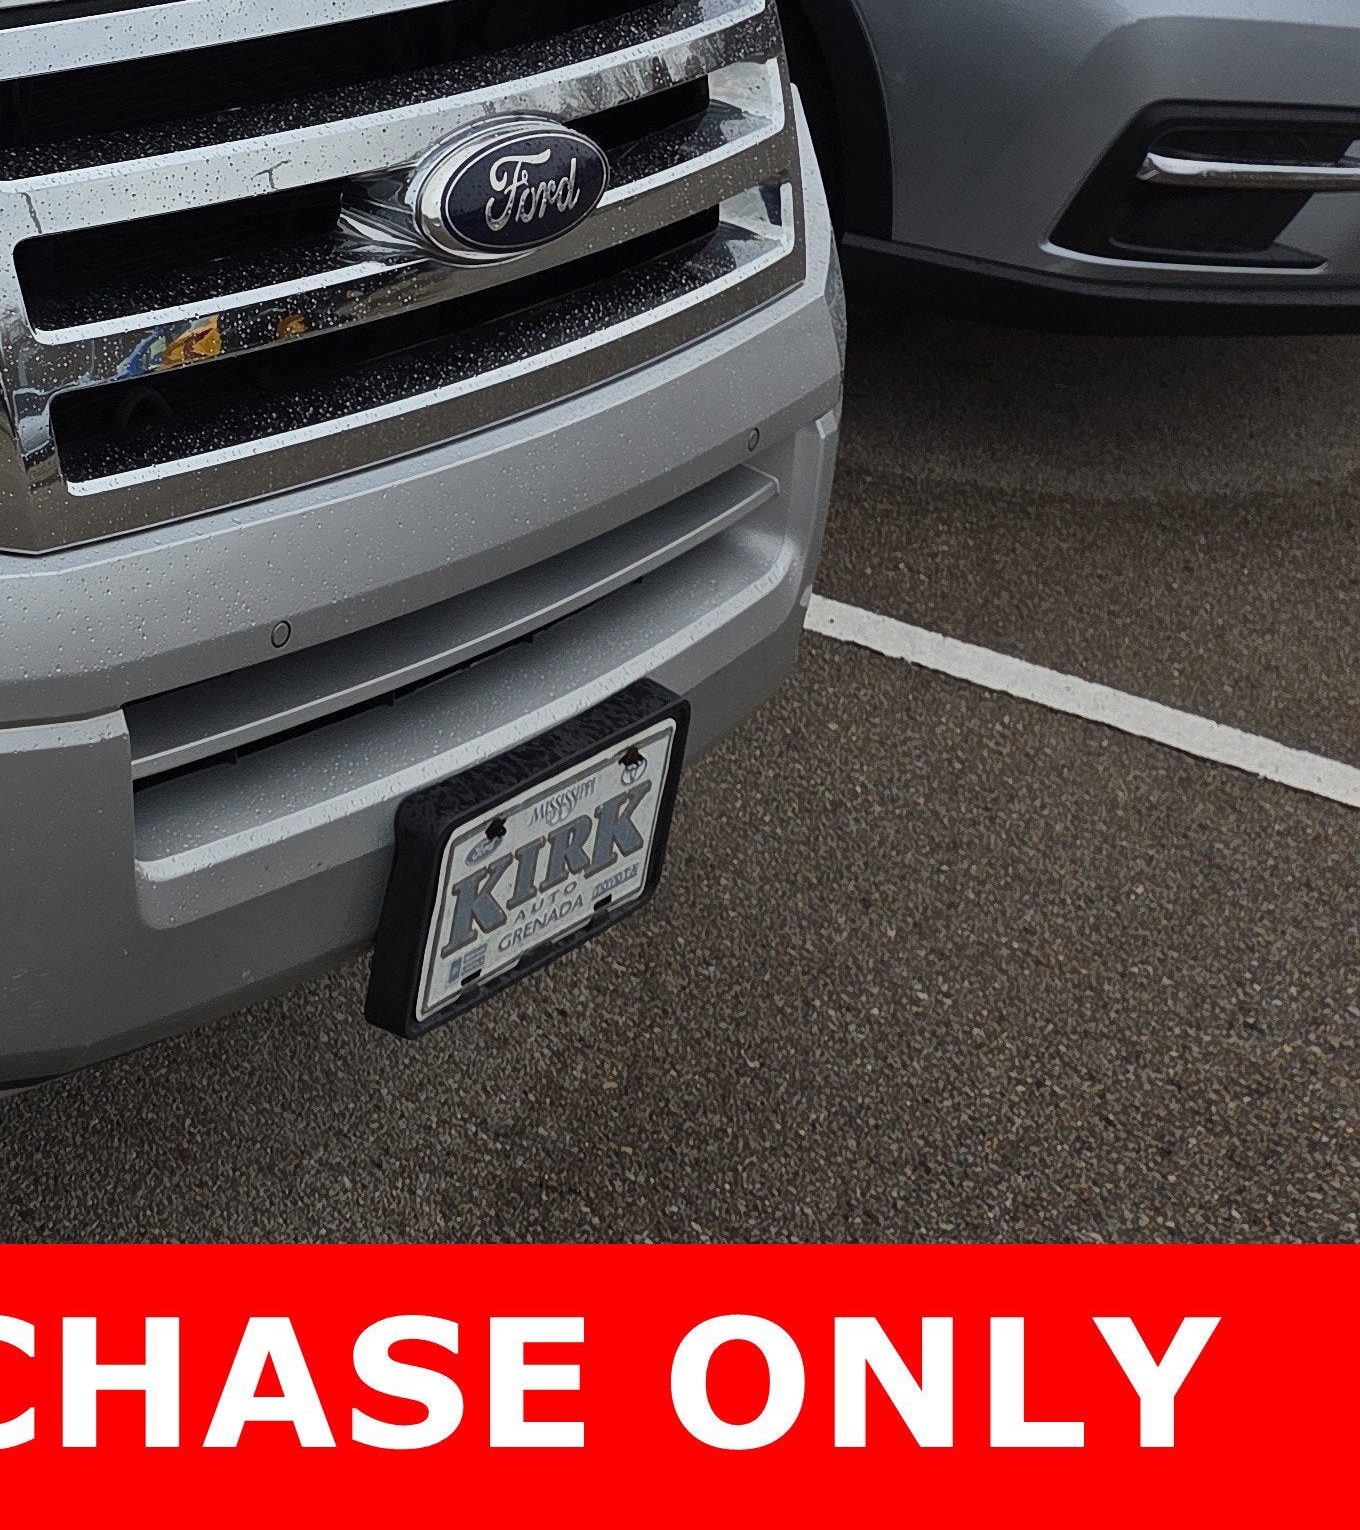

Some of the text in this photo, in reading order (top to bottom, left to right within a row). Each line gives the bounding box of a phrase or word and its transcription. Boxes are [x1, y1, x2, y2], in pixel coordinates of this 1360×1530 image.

[483, 148, 581, 232] Ford
[441, 778, 652, 960] KIRK
[513, 880, 578, 925] AUTO
[498, 894, 584, 953] GRENADA
